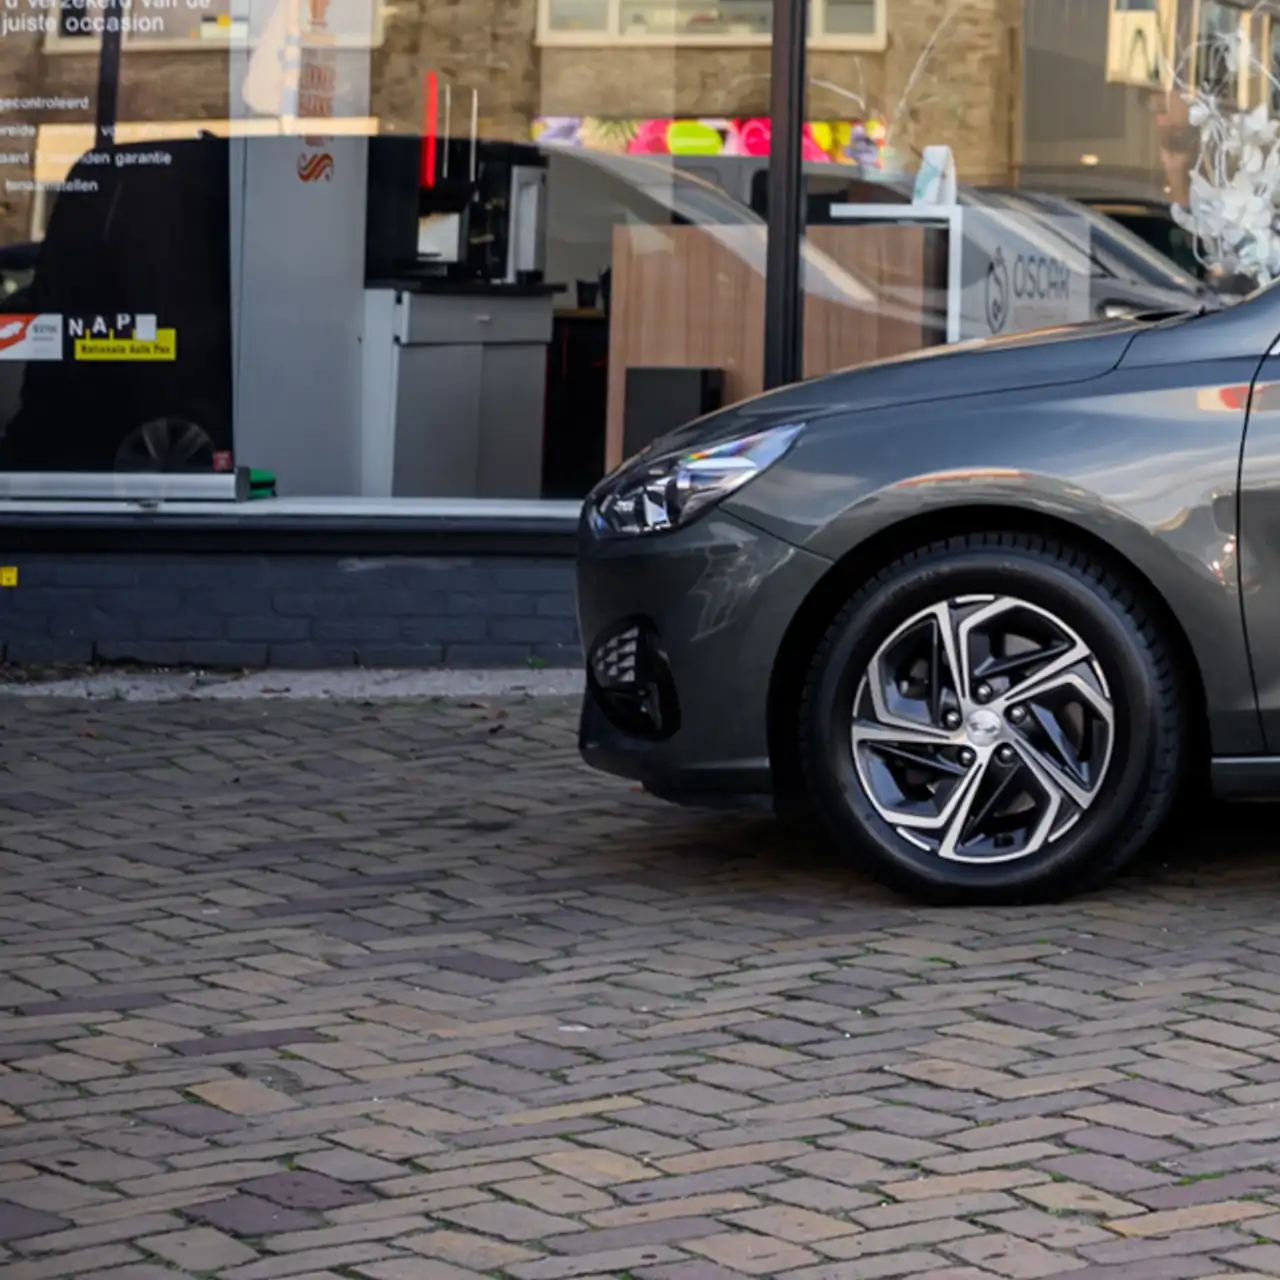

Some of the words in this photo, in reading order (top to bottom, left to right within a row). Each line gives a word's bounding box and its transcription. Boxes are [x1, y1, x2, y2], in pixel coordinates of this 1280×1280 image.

[2, 14, 56, 36] juiste
[65, 16, 165, 33] occasion
[115, 151, 172, 168] garantie
